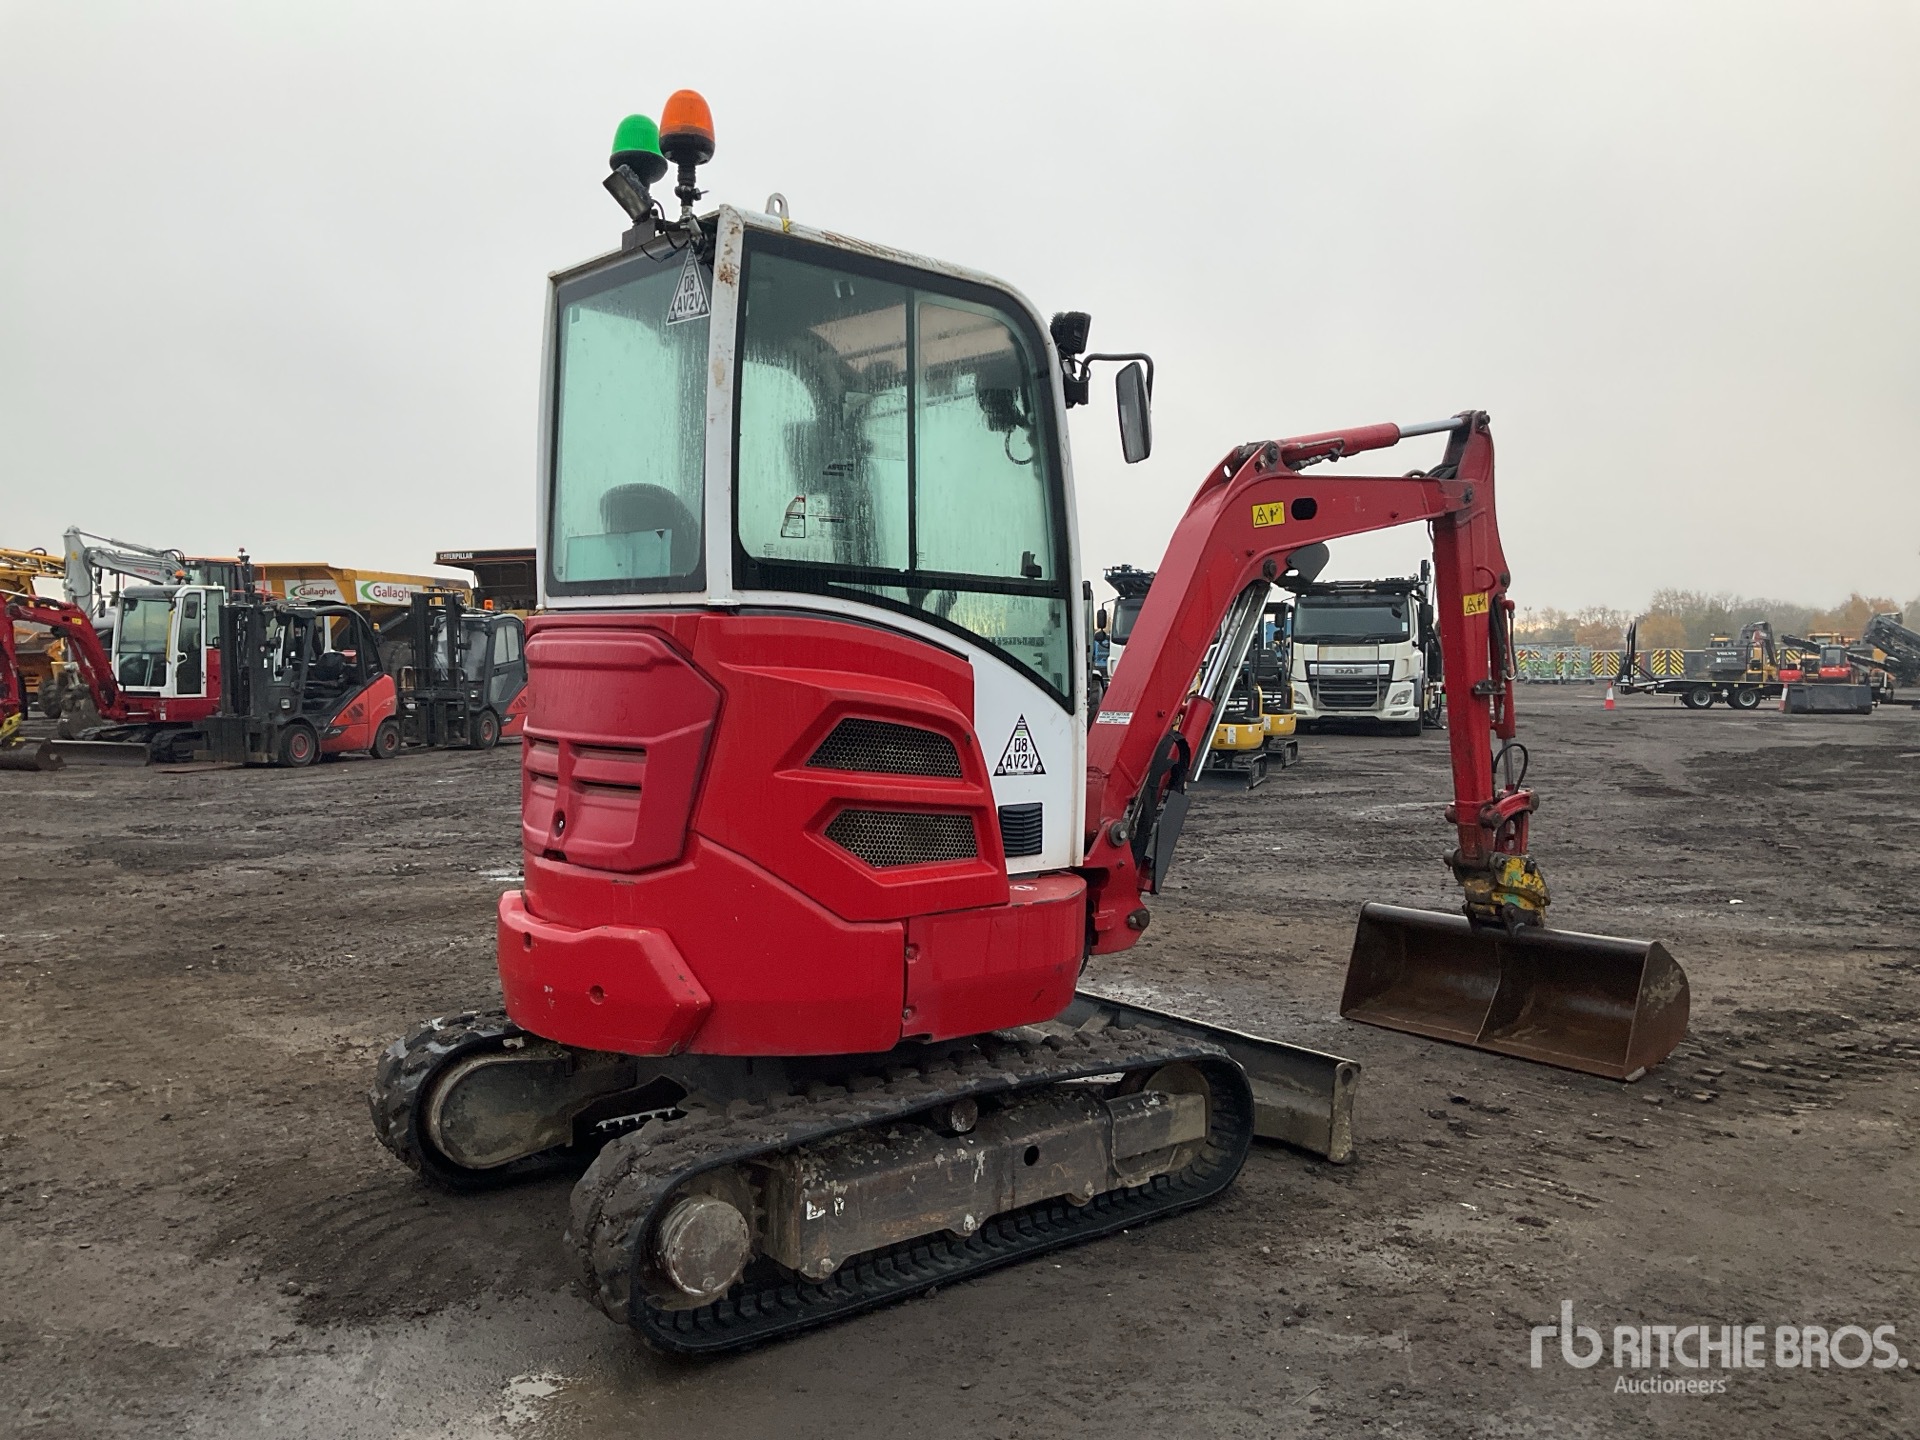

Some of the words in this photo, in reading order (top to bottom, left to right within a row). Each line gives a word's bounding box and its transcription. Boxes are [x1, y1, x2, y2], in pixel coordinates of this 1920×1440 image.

[676, 291, 702, 313] AV2V
[299, 587, 336, 597] Gallagher
[372, 585, 412, 602] Gallagh
[1334, 667, 1363, 675] DAF
[1005, 753, 1036, 770] AV2V
